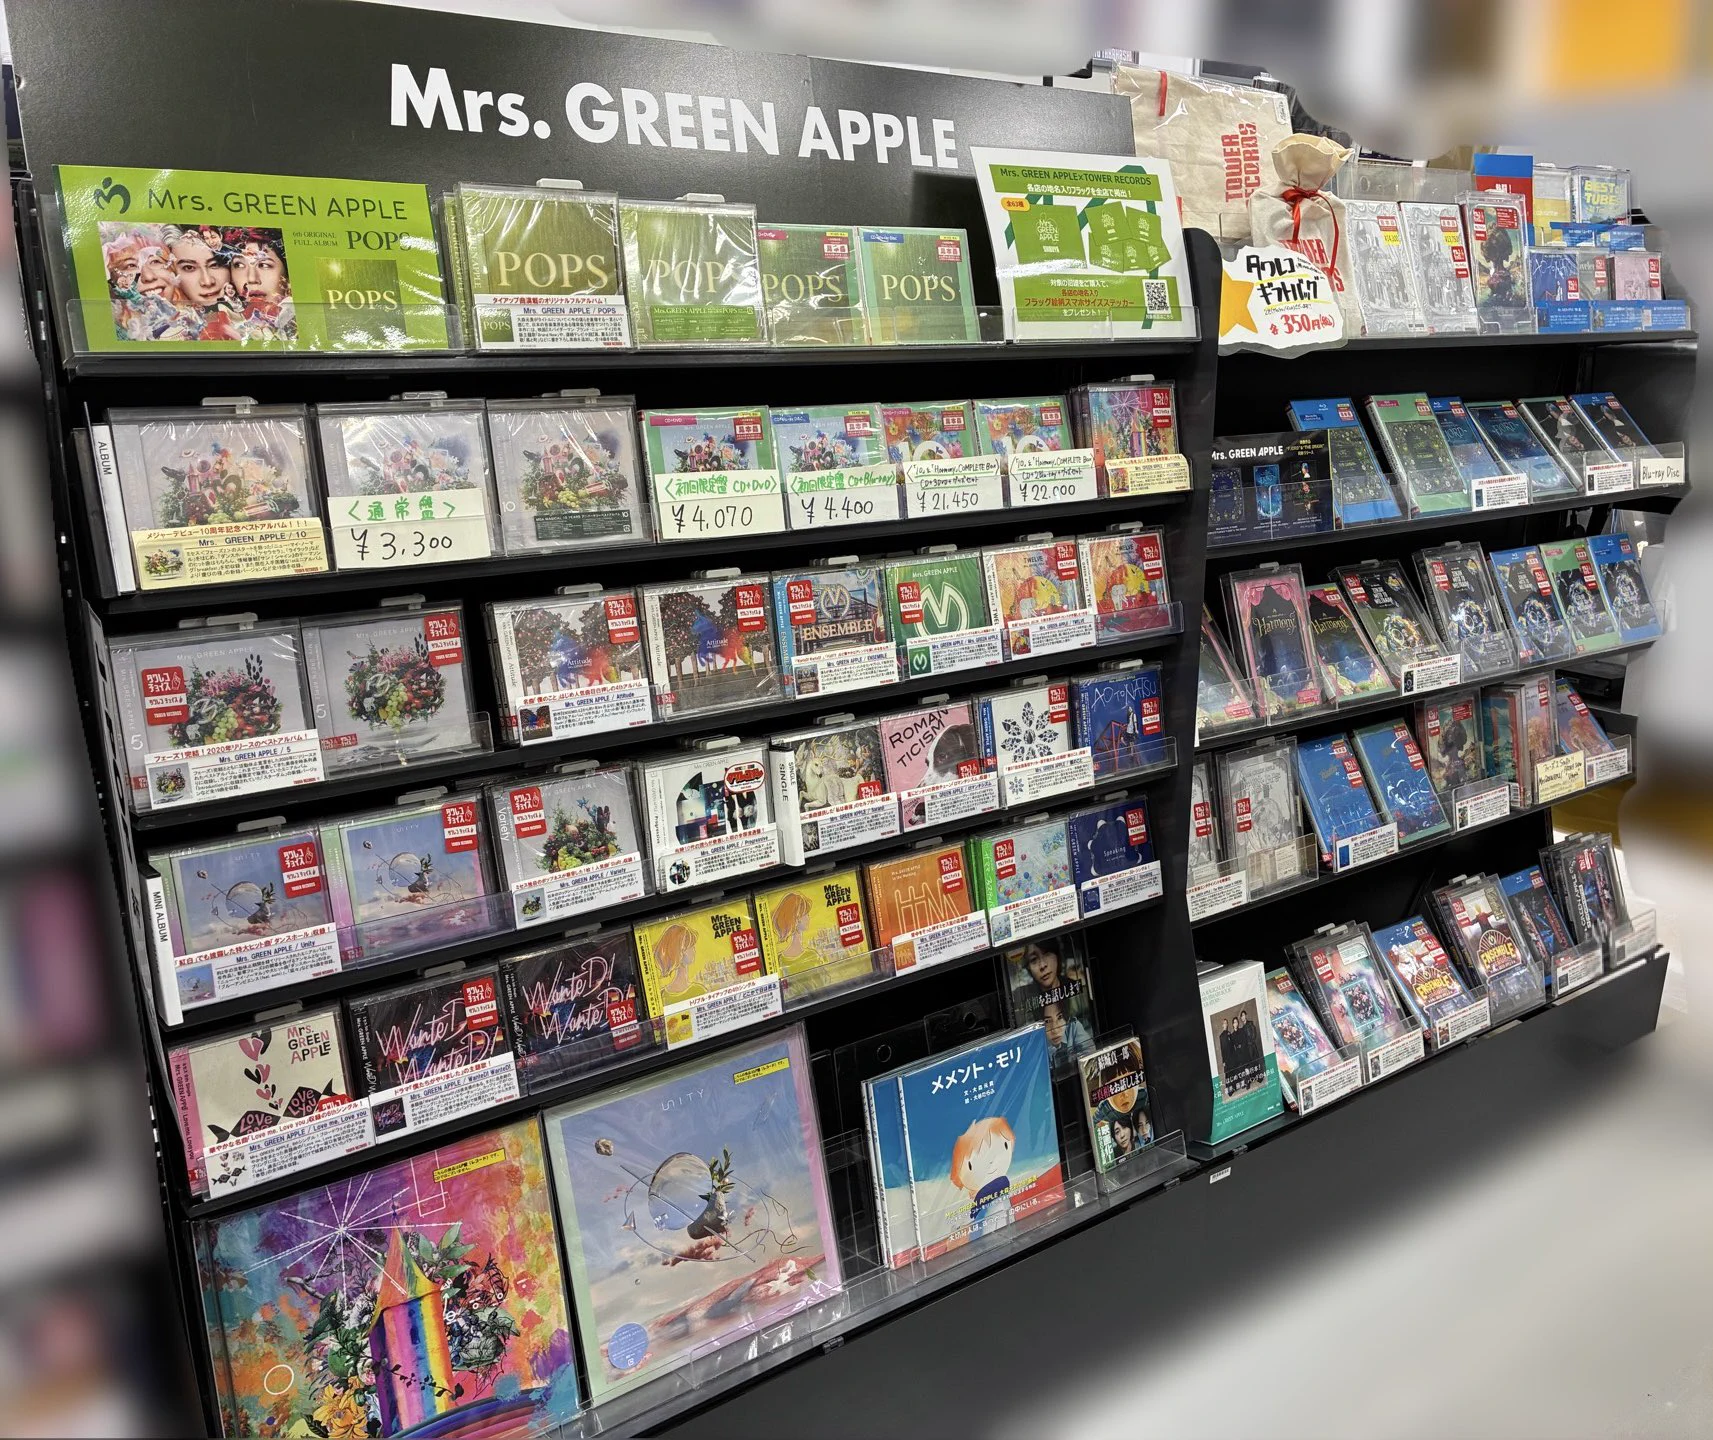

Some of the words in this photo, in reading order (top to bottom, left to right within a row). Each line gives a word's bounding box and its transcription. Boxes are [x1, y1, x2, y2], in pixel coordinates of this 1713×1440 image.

[390, 63, 551, 140] Mrs.
[565, 82, 780, 156] GREEN
[798, 106, 959, 169] APPLE
[1221, 134, 1243, 203] TOWER
[1238, 121, 1261, 209] ECORDS
[1000, 168, 1020, 178] Mrs.
[1021, 170, 1051, 180] GREEN
[1114, 175, 1152, 187] RECORDS
[1583, 180, 1614, 193] BEST
[147, 189, 213, 213] Mrs.
[223, 192, 317, 217] GREEN
[327, 197, 408, 220] APPLE
[303, 231, 337, 240] ORIGINAL
[1036, 226, 1058, 235] GREEN
[1039, 232, 1060, 242] APPLE
[293, 239, 312, 247] FULL
[313, 240, 338, 248] ALBUM
[496, 251, 609, 289] POPS
[1246, 254, 1295, 280] タワレコ
[762, 273, 843, 303] POPS
[881, 274, 956, 301] POPS
[1256, 276, 1320, 306] ギフトバッグ
[327, 289, 399, 311] POPS
[483, 321, 511, 331] POPS
[98, 440, 113, 476] ALBUM
[1228, 446, 1257, 459] GREEN
[1258, 445, 1284, 457] APPLE
[1642, 464, 1665, 481] Blu-ray
[1666, 466, 1681, 480] Disc
[502, 501, 516, 512] 10
[198, 538, 218, 547] Mrs.
[224, 535, 255, 544] GREEN
[259, 532, 286, 541] APPLE
[350, 527, 453, 561] ¥3,300
[1024, 555, 1043, 564] TWELVE
[803, 618, 874, 640] ENSEMBLE
[1253, 611, 1296, 637] Harmony
[1310, 614, 1350, 635] Harmony
[706, 636, 729, 647] Attitude
[197, 650, 225, 660] GREEN
[567, 656, 592, 666] Attitude
[316, 703, 327, 718] 5
[889, 707, 949, 749] ROMAN
[131, 734, 143, 750] 5
[897, 718, 945, 768] TICISM
[778, 763, 789, 802] SINGLE
[787, 761, 796, 786] SINGLE
[498, 806, 510, 842] Variety
[1103, 846, 1126, 857] Speaking
[823, 884, 841, 894] Mrs.
[824, 887, 851, 901] GREEN
[152, 890, 161, 911] MINI
[826, 896, 851, 908] APPLE
[155, 912, 168, 942] ALBUM
[710, 914, 732, 924] Mrs.
[712, 917, 742, 932] GREEN
[236, 955, 248, 963] Mrs.
[251, 950, 272, 960] GREEN
[273, 945, 293, 956] APPLE
[1480, 940, 1515, 970] ENSEMBLE
[522, 952, 616, 1012] WanteD!
[1415, 974, 1450, 999] ENSEMBLE
[540, 984, 632, 1043] WanteD!
[287, 1024, 314, 1040] Mrs.
[376, 998, 466, 1058] WanteD
[288, 1030, 330, 1050] GREEN
[290, 1040, 331, 1064] APPLE
[930, 1046, 1022, 1095] メメント・モリ
[410, 1092, 421, 1100] Mrs.
[423, 1087, 442, 1096] GREEN
[443, 1080, 461, 1090] APPLE
[249, 1144, 262, 1152] Mrs.
[264, 1137, 285, 1147] GREEN
[286, 1129, 306, 1141] APPLE
[313, 1121, 328, 1132] Love
[341, 1114, 355, 1123] Love
[356, 1110, 367, 1119] you
[279, 1123, 294, 1132] Love
[979, 1191, 999, 1205] APPLE
